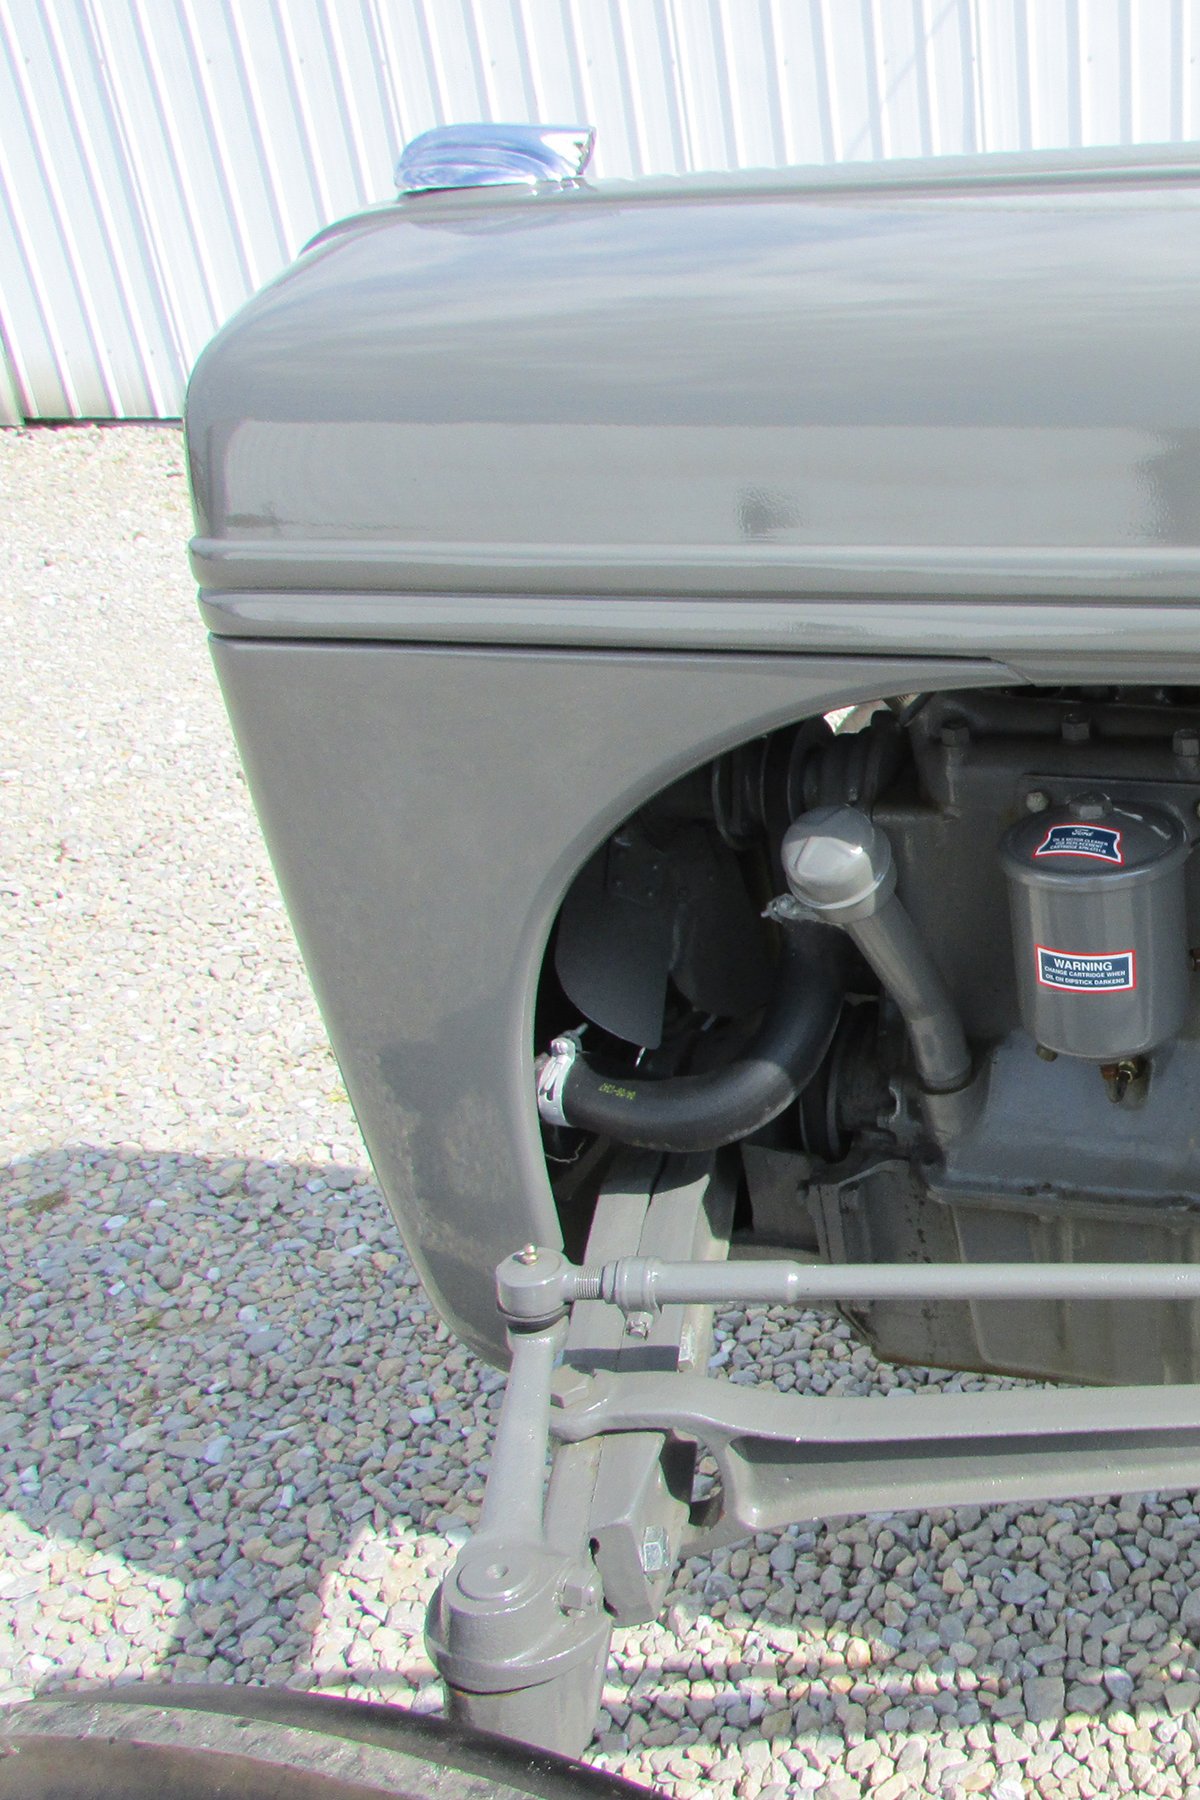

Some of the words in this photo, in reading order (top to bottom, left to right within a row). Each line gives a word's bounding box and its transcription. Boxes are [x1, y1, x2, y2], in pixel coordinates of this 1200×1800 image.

[1054, 958, 1113, 972] WARNING
[1044, 966, 1067, 975] CHANGE
[1094, 977, 1125, 985] DARKENS
